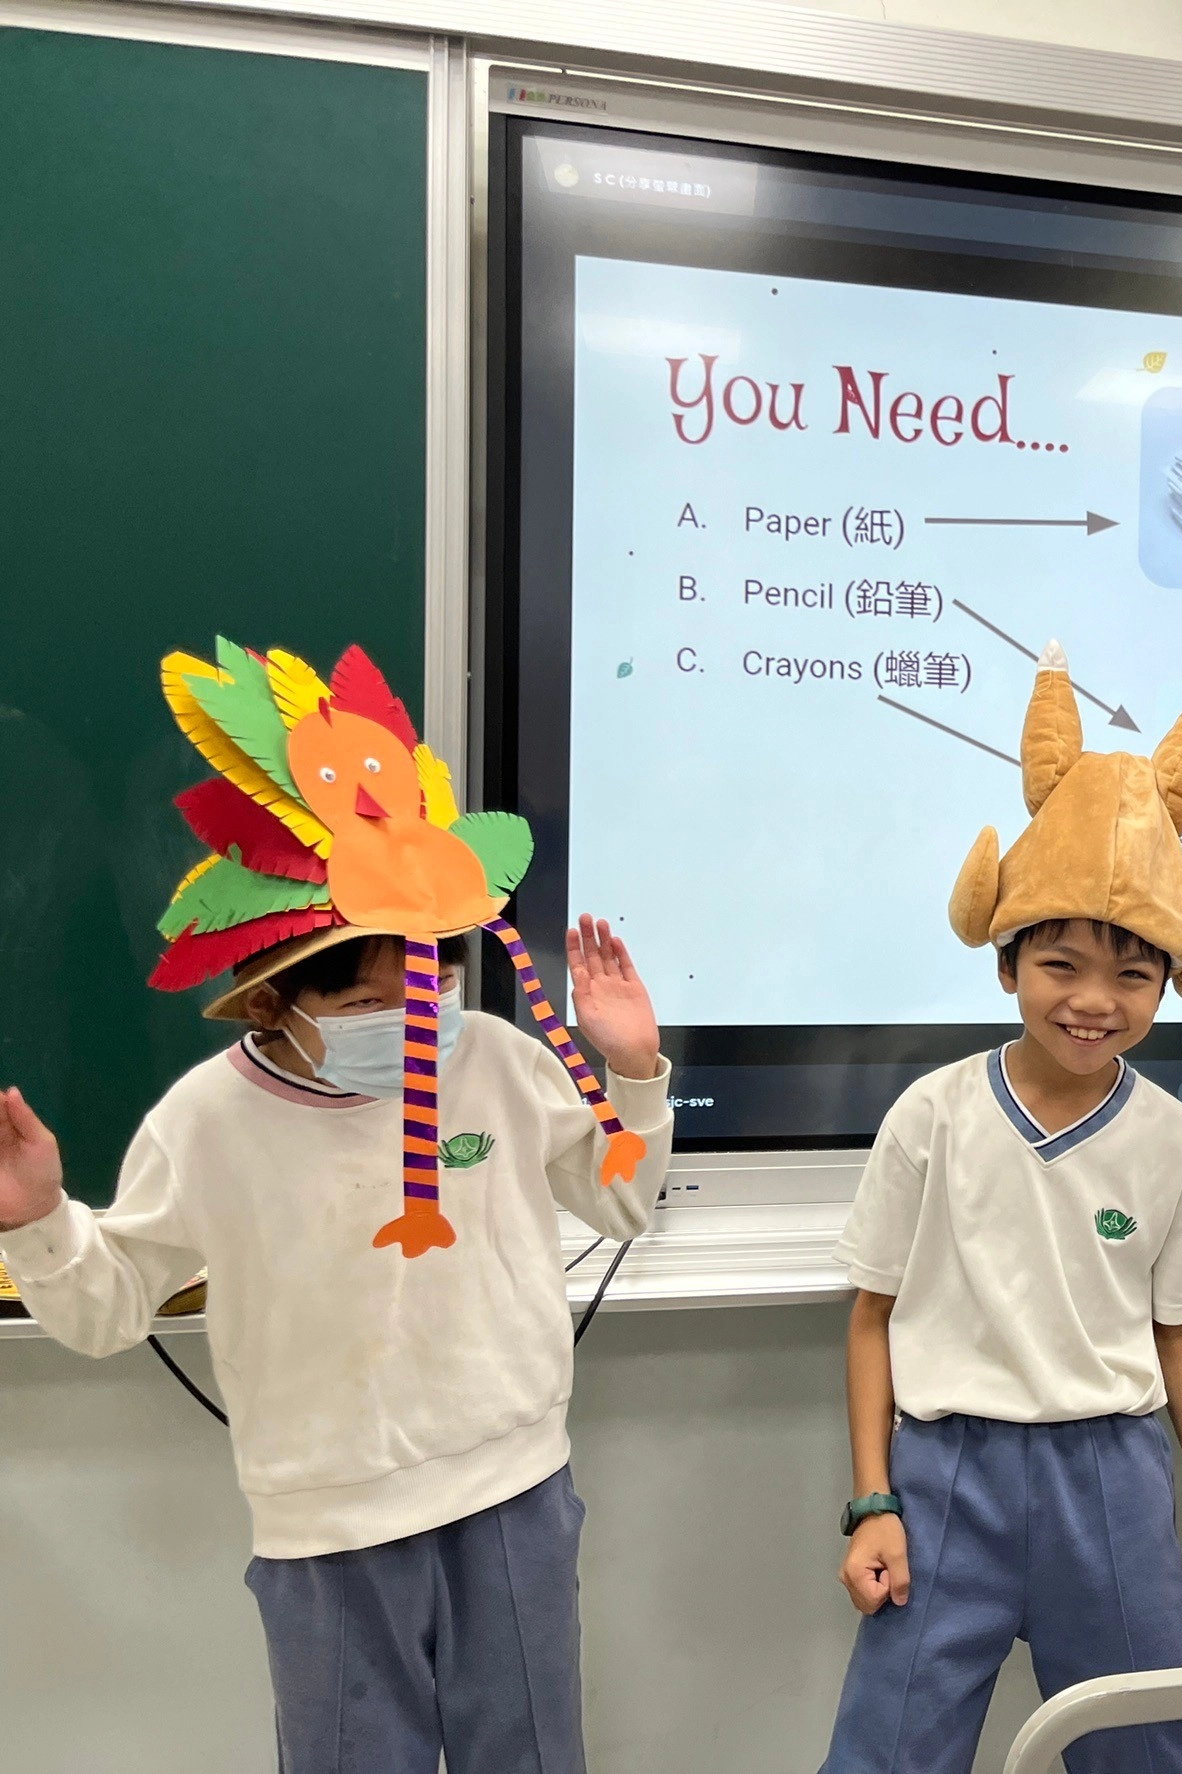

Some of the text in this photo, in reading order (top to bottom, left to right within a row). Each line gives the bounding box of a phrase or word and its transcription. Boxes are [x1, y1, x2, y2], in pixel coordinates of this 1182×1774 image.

[548, 93, 607, 111] PERSONA
[665, 353, 808, 445] You
[677, 502, 905, 549] A. Paper (紙)
[678, 576, 944, 622] B. Pencil (鉛筆)
[676, 647, 972, 693] C. Crayons (蠟筆)
